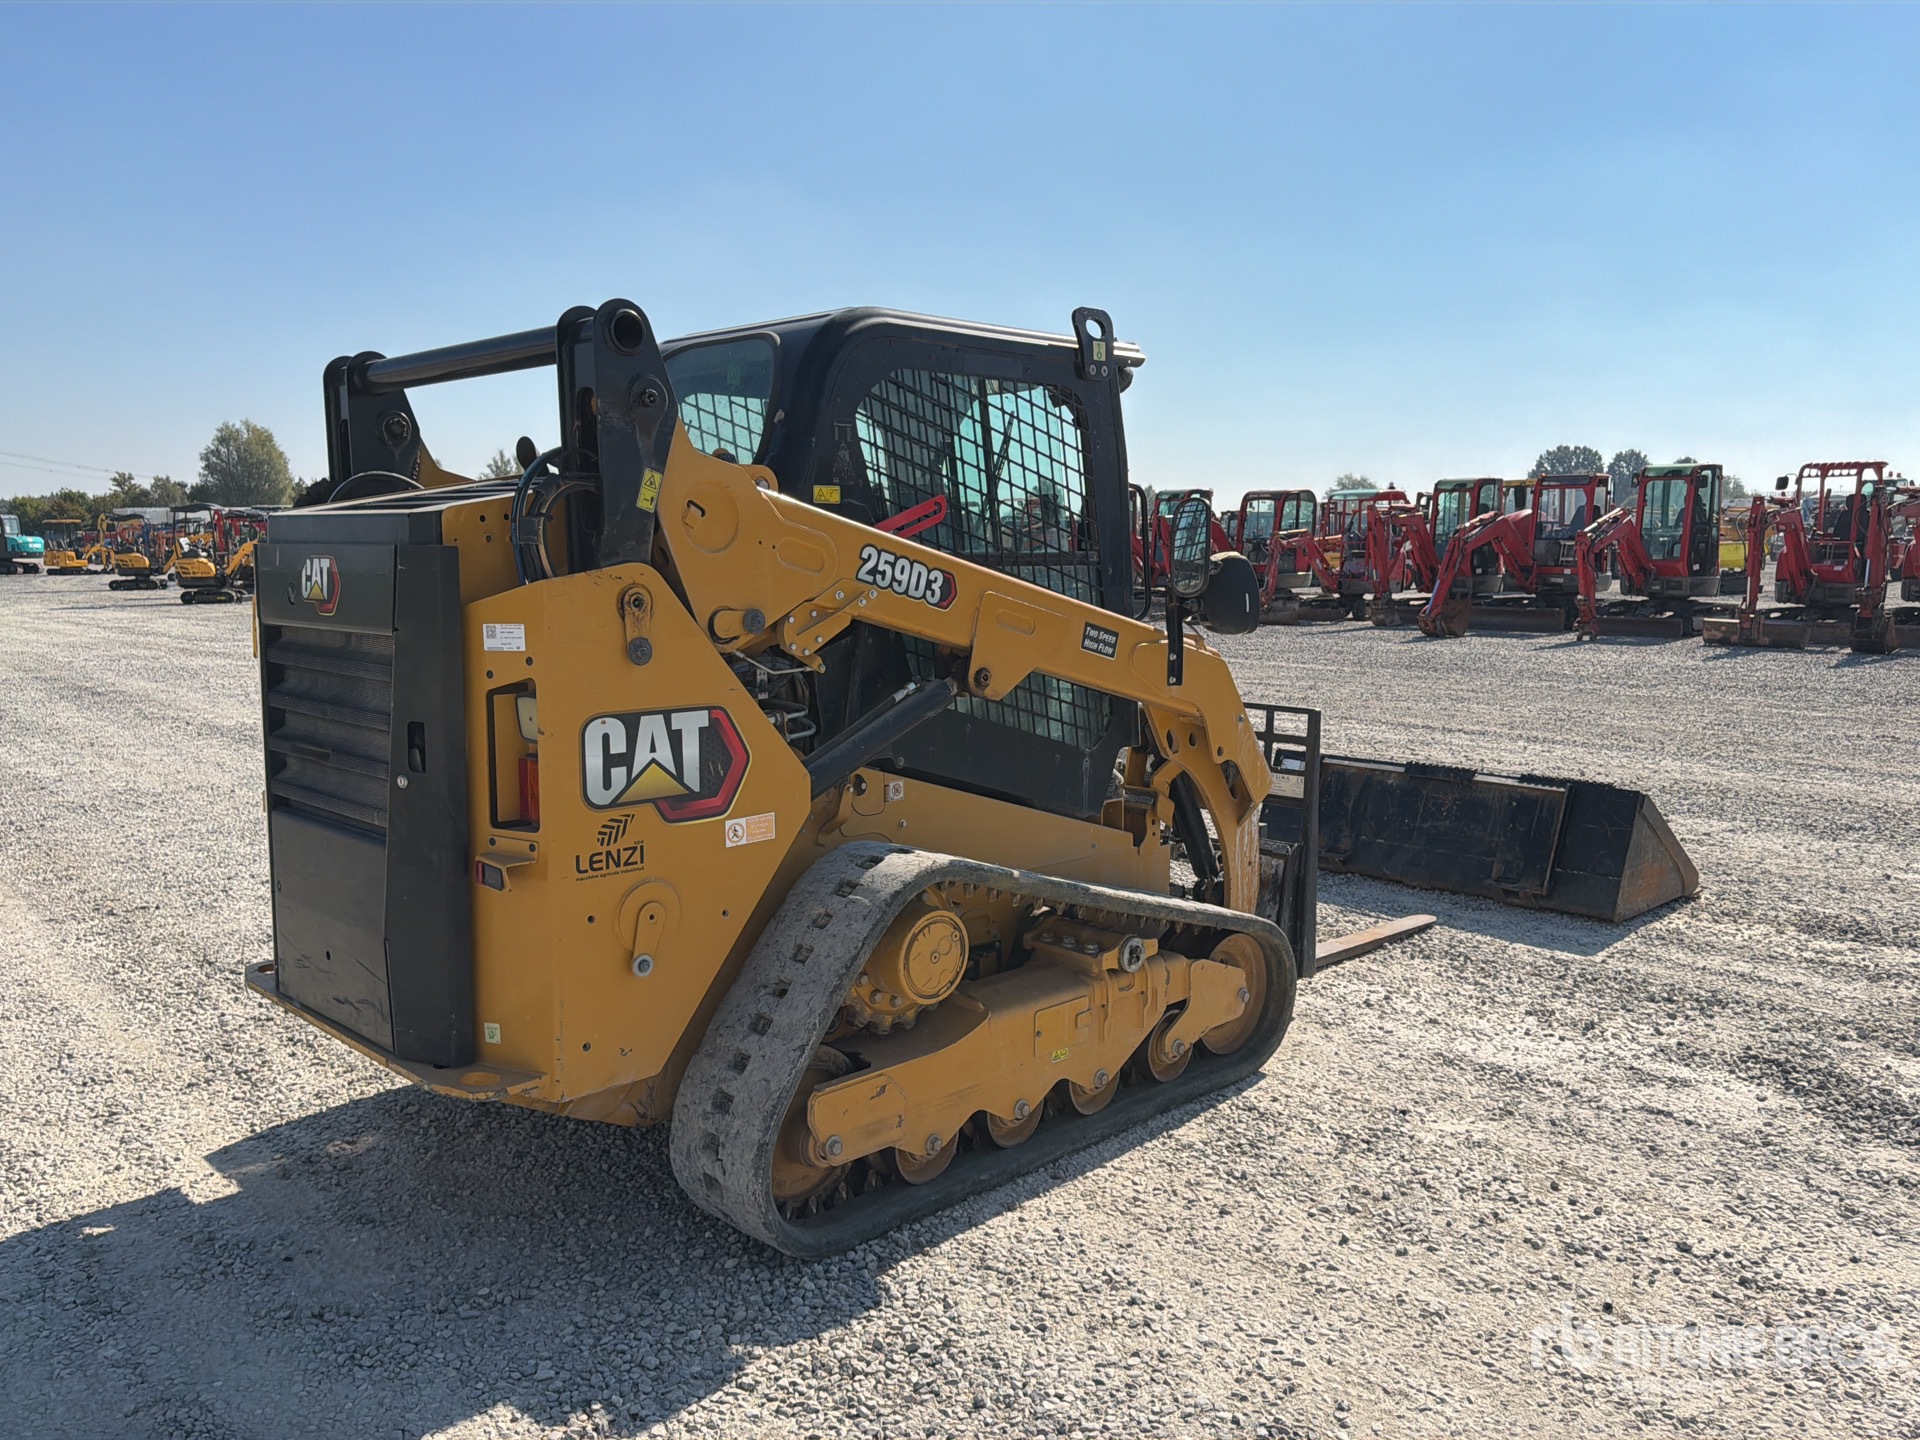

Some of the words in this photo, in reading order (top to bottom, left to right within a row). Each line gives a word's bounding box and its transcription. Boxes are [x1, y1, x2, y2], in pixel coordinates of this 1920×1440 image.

[301, 558, 330, 600] CAT
[858, 546, 943, 604] 259D3
[584, 709, 710, 806] CAT
[575, 844, 645, 874] LENZI
[575, 873, 599, 882] macchine
[599, 870, 620, 878] agricole
